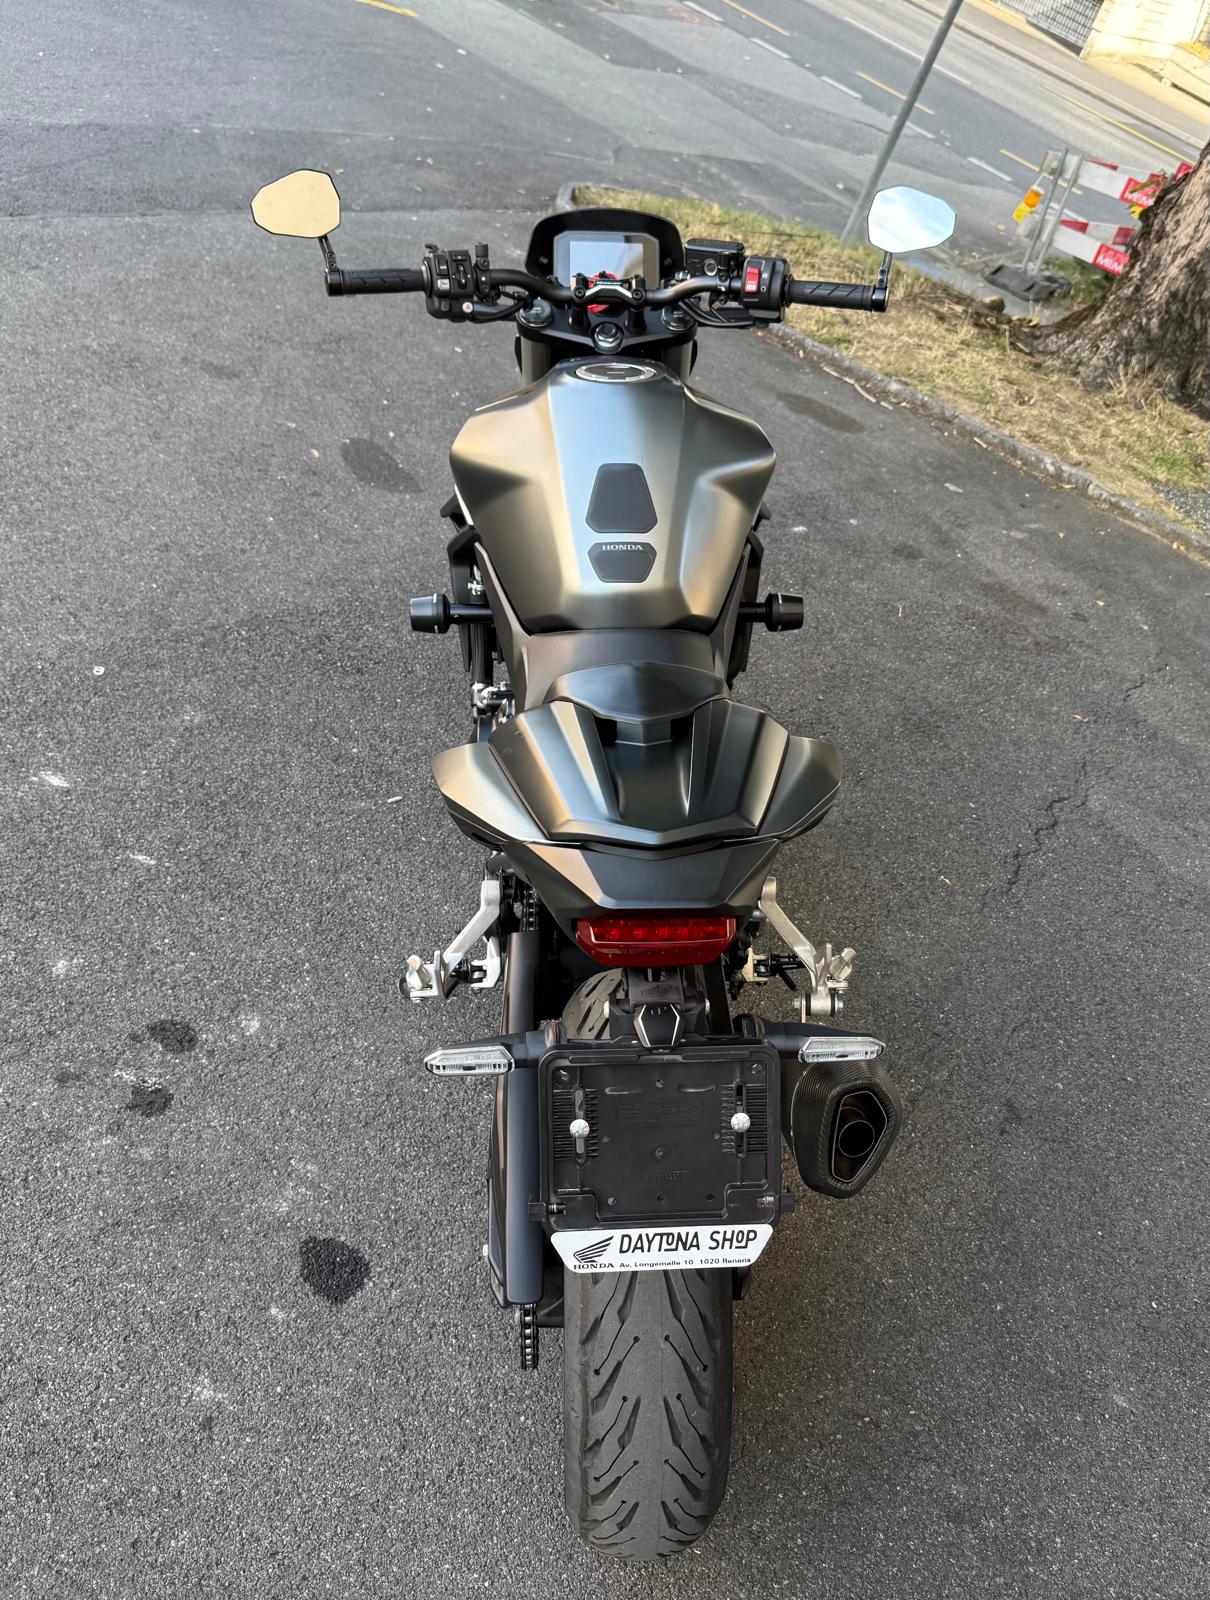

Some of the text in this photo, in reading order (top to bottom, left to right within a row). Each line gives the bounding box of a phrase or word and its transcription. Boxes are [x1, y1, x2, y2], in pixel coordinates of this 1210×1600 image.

[618, 1229, 758, 1254] DAYTONA SHOP
[699, 1257, 720, 1265] 1020
[573, 1262, 615, 1270] HONDA
